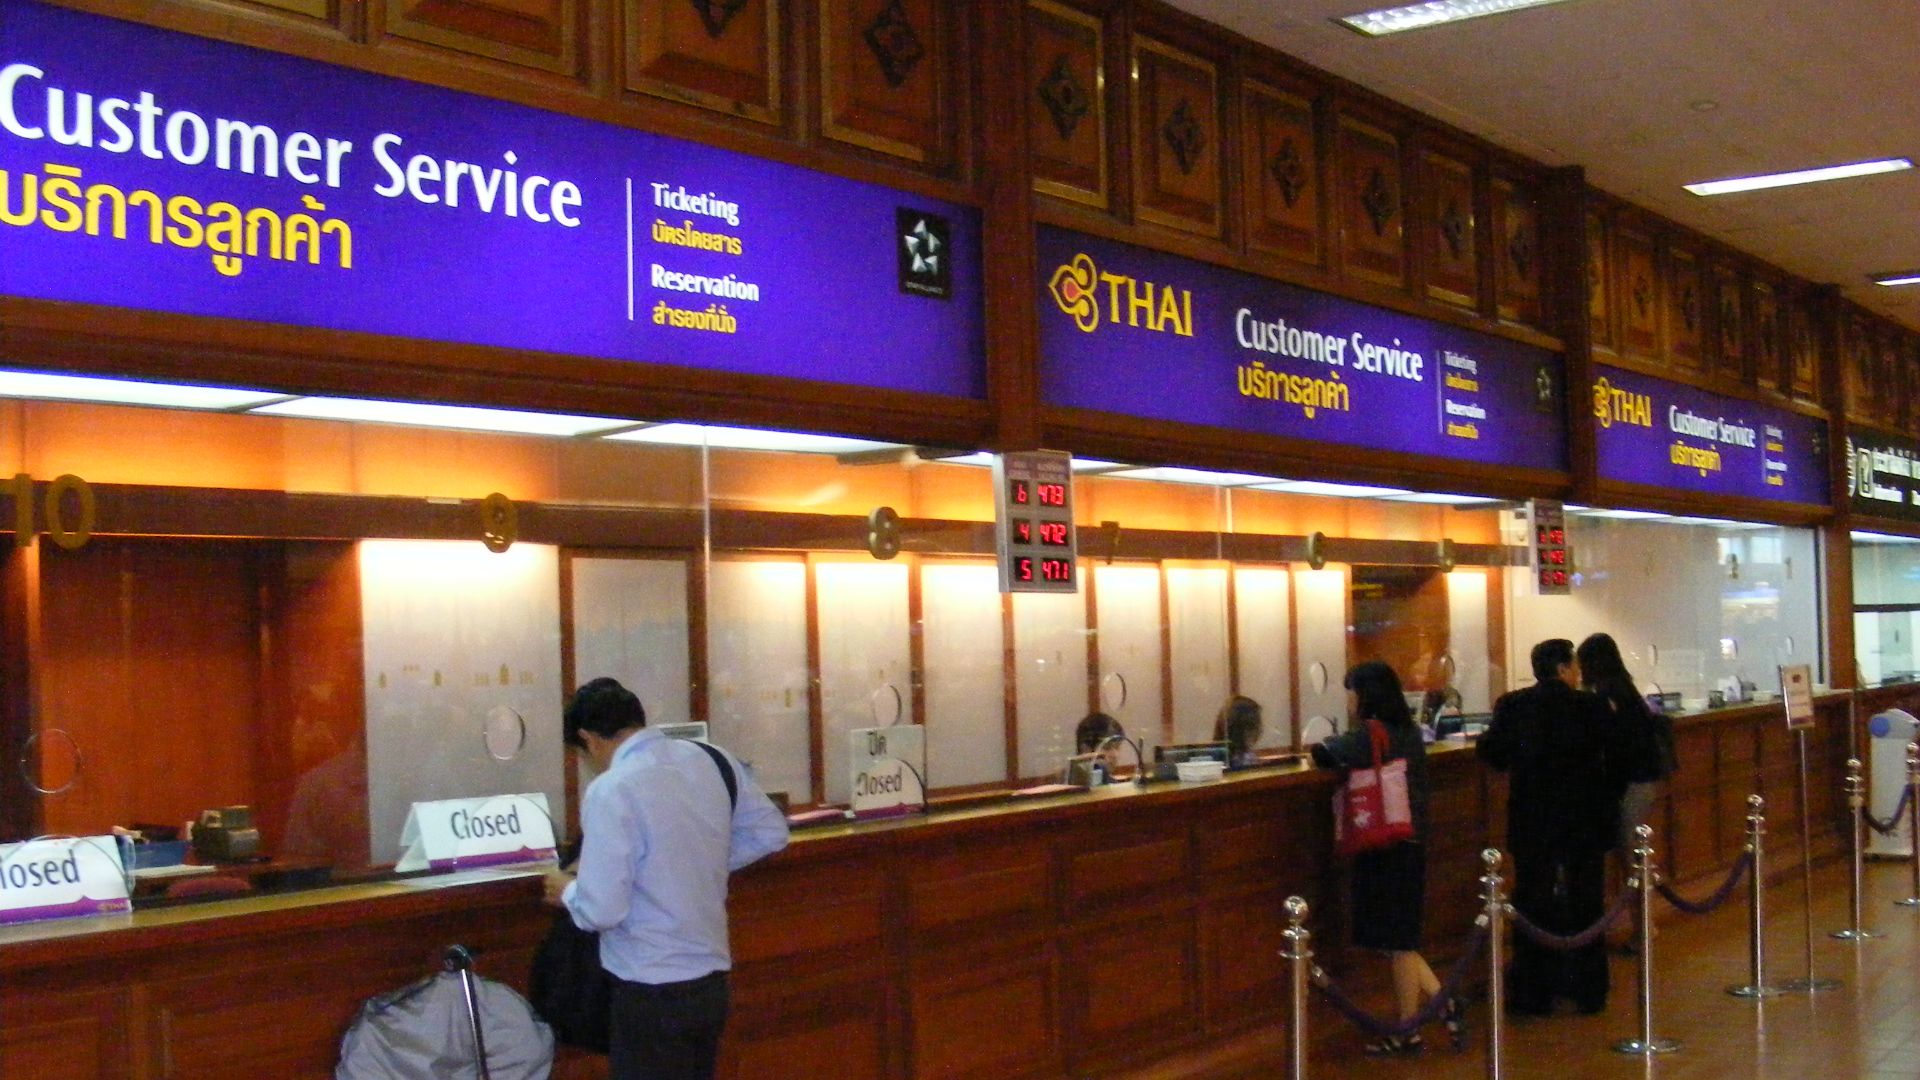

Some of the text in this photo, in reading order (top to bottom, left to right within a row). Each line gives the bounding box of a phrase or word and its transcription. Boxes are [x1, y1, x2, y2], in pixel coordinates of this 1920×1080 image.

[0, 63, 583, 227] Customer Service
[0, 163, 353, 277] บริการลูกค้า
[651, 182, 740, 226] Ticketing
[651, 263, 759, 301] Reservation
[1101, 271, 1193, 337] THAI
[1236, 308, 1423, 382] Customer Service
[1610, 387, 1652, 427] THAI
[1669, 404, 1717, 441] Customer
[1718, 416, 1756, 449] Service
[1038, 484, 1065, 505] 473
[868, 506, 900, 560] 8
[1019, 521, 1067, 544] 4 472
[1021, 559, 1069, 580] 5 471
[450, 804, 522, 840] Closed
[0, 848, 81, 890] losed
